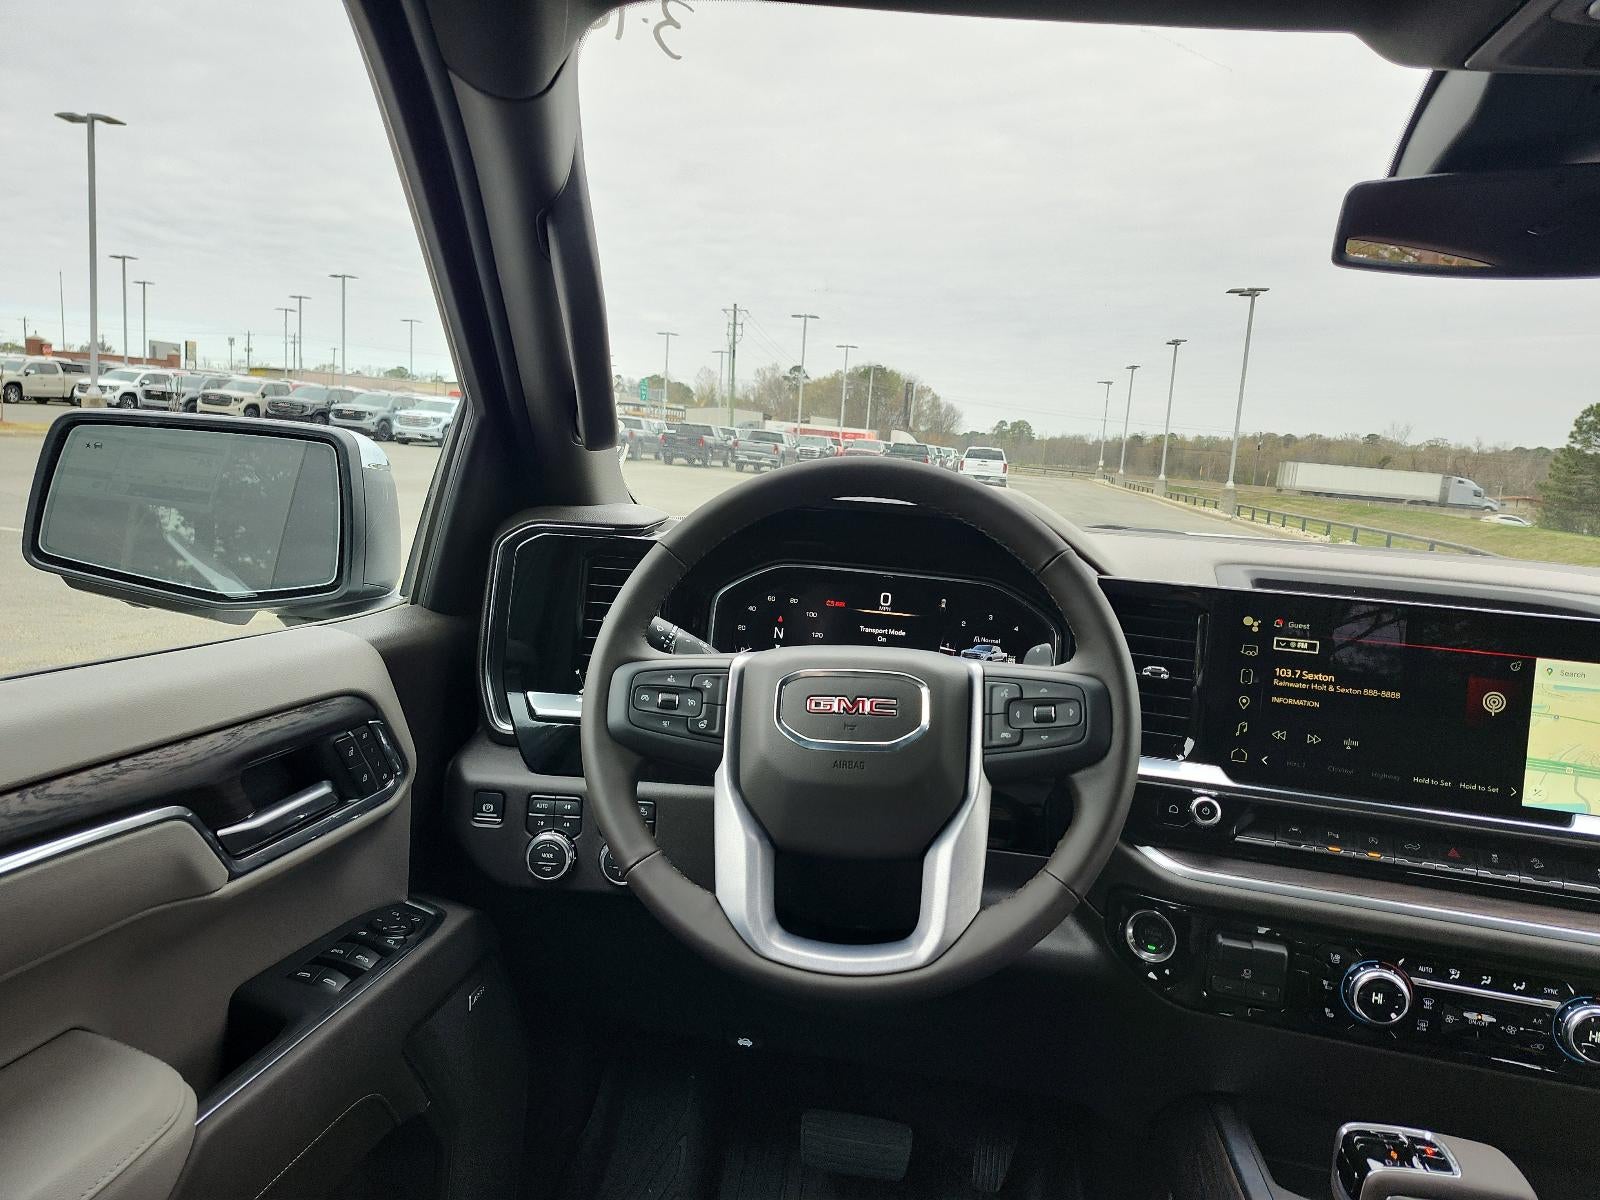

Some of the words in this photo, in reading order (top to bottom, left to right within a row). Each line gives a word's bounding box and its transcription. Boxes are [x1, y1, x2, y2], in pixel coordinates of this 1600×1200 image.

[880, 592, 892, 606] 0
[860, 625, 888, 634] Transport
[1288, 622, 1310, 630] Guest
[773, 626, 784, 639] N
[1274, 667, 1301, 679] 103.7
[1302, 671, 1335, 682] Sexton
[1560, 670, 1586, 679] Search
[1273, 679, 1309, 689] Rainwater
[1311, 683, 1327, 692] Holt
[1336, 686, 1361, 695] Sexton
[806, 694, 898, 717] GMC
[1271, 696, 1320, 708] INFORMATION
[832, 761, 865, 770] AIRBAG
[1413, 776, 1429, 784] Hold
[1460, 782, 1476, 790] Hold
[1418, 965, 1433, 973] AUTO
[1372, 992, 1383, 1004] HI
